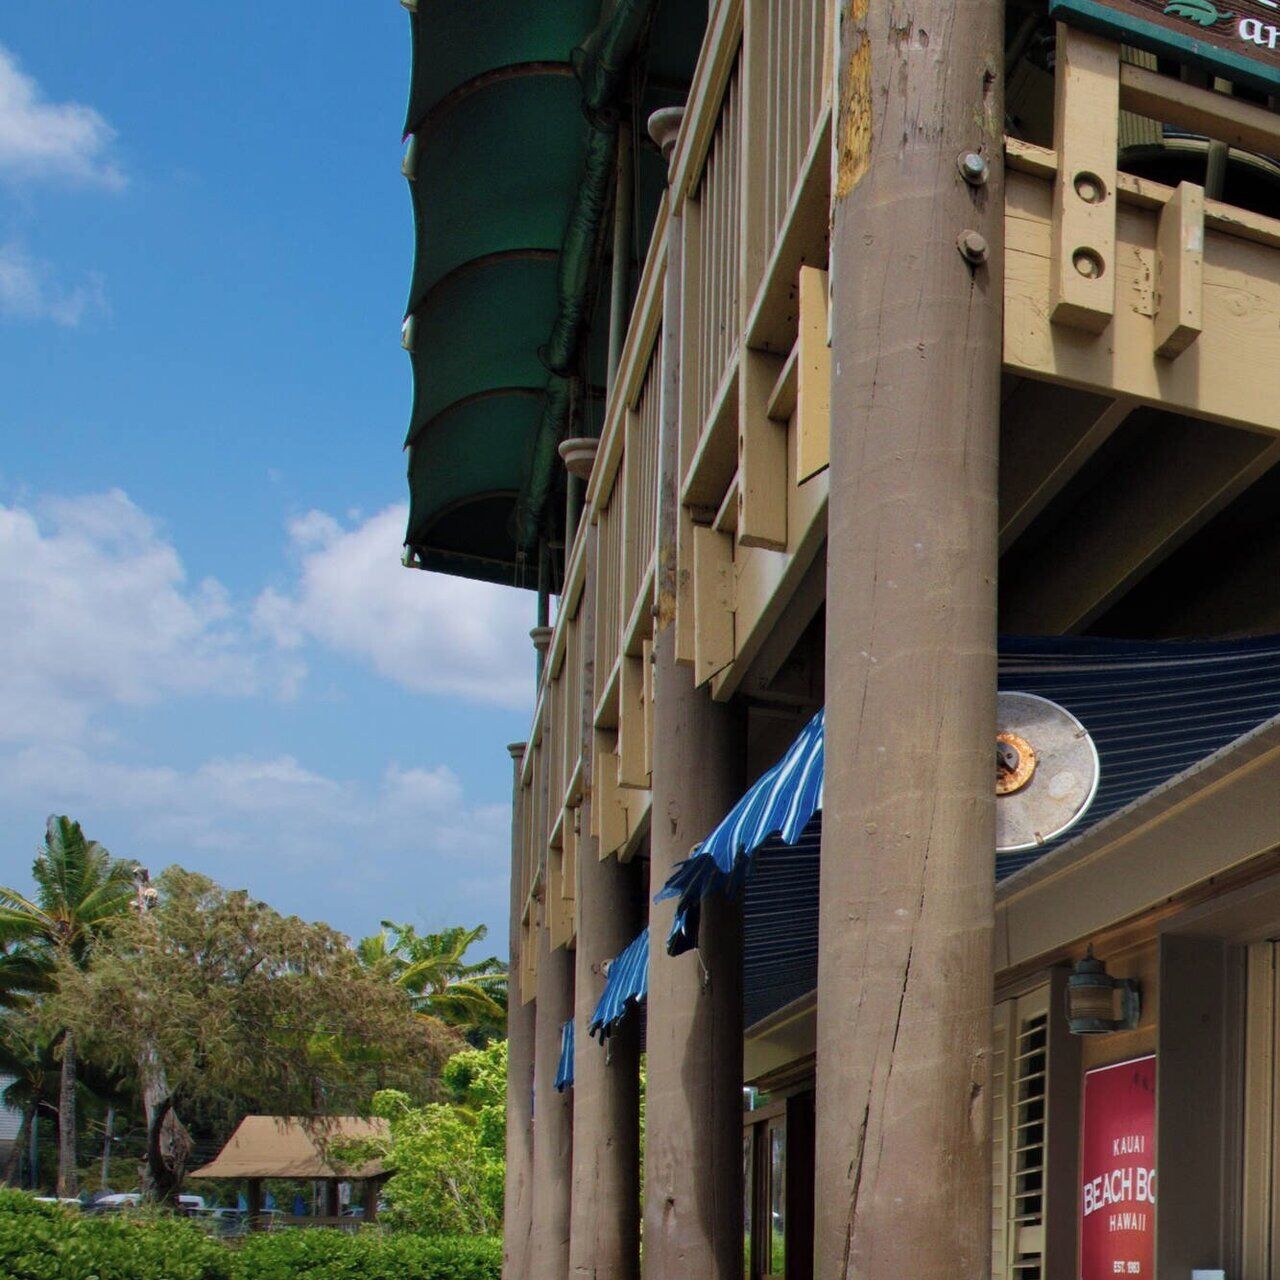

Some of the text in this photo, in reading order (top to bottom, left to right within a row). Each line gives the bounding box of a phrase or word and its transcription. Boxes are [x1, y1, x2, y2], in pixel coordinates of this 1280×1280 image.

[1113, 1136, 1145, 1156] KAUAI
[1083, 1167, 1133, 1217] BEACH
[1109, 1212, 1146, 1232] HAWAII
